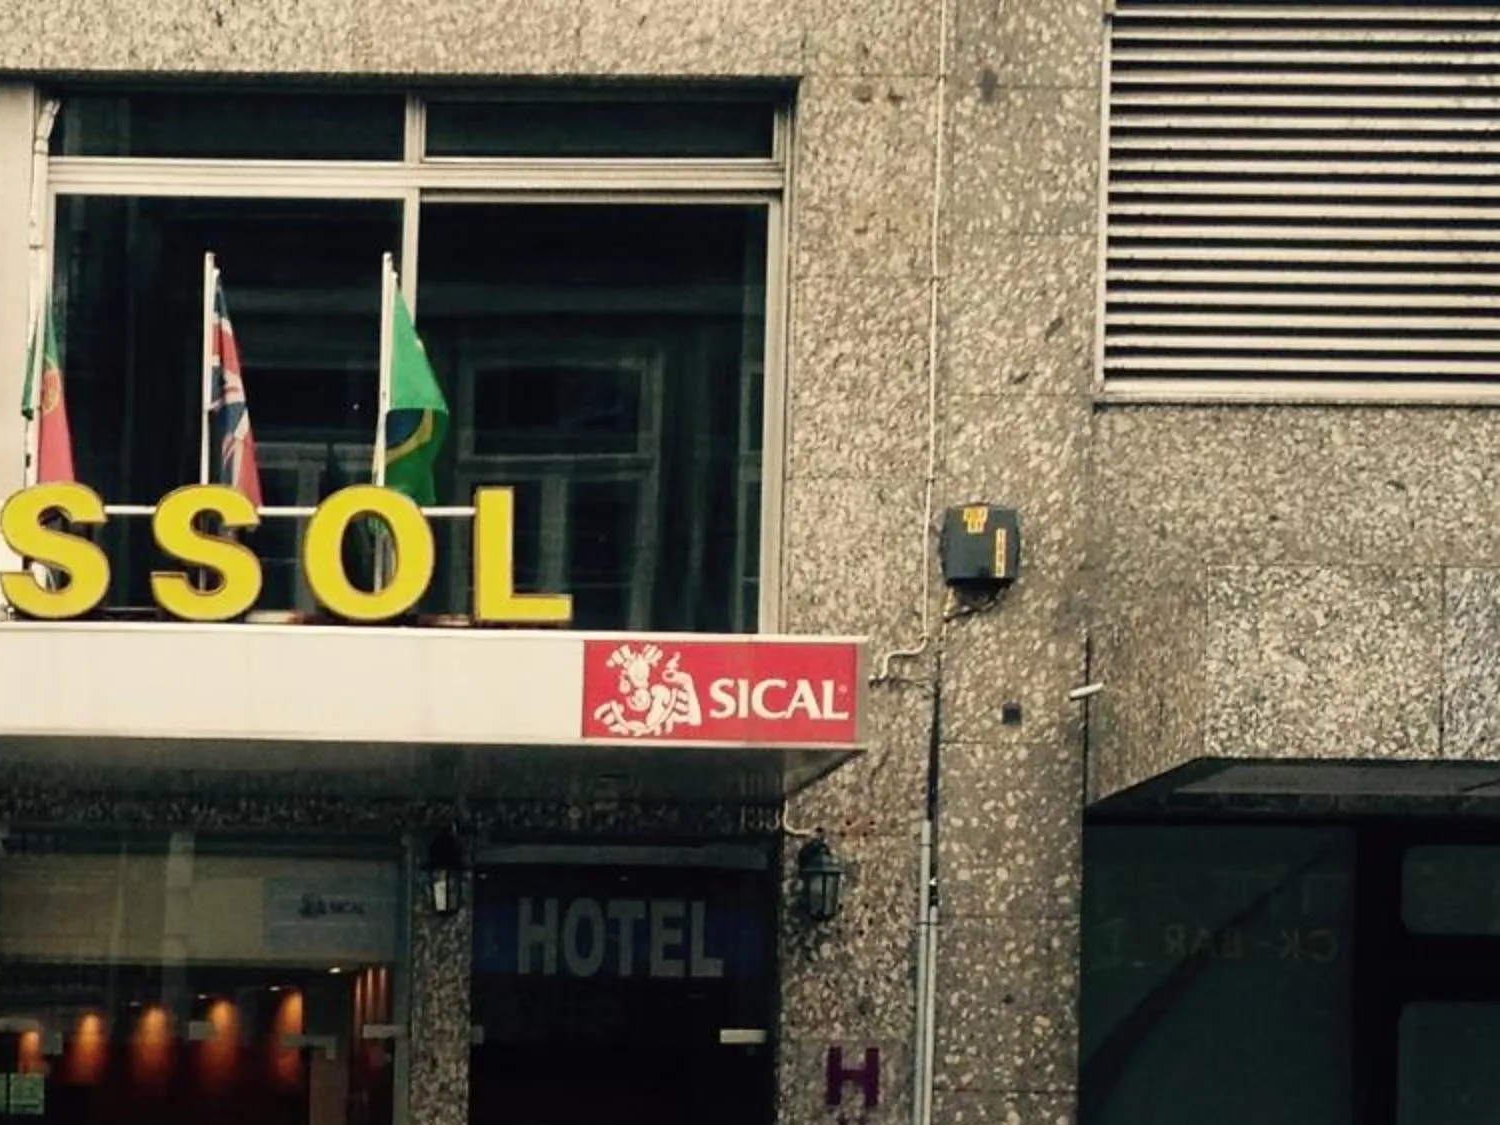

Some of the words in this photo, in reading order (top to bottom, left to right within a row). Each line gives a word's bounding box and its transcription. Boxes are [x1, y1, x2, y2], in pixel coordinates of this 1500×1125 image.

[709, 678, 849, 721] SICAL
[516, 896, 725, 979] HOTEL
[826, 1046, 880, 1107] H
